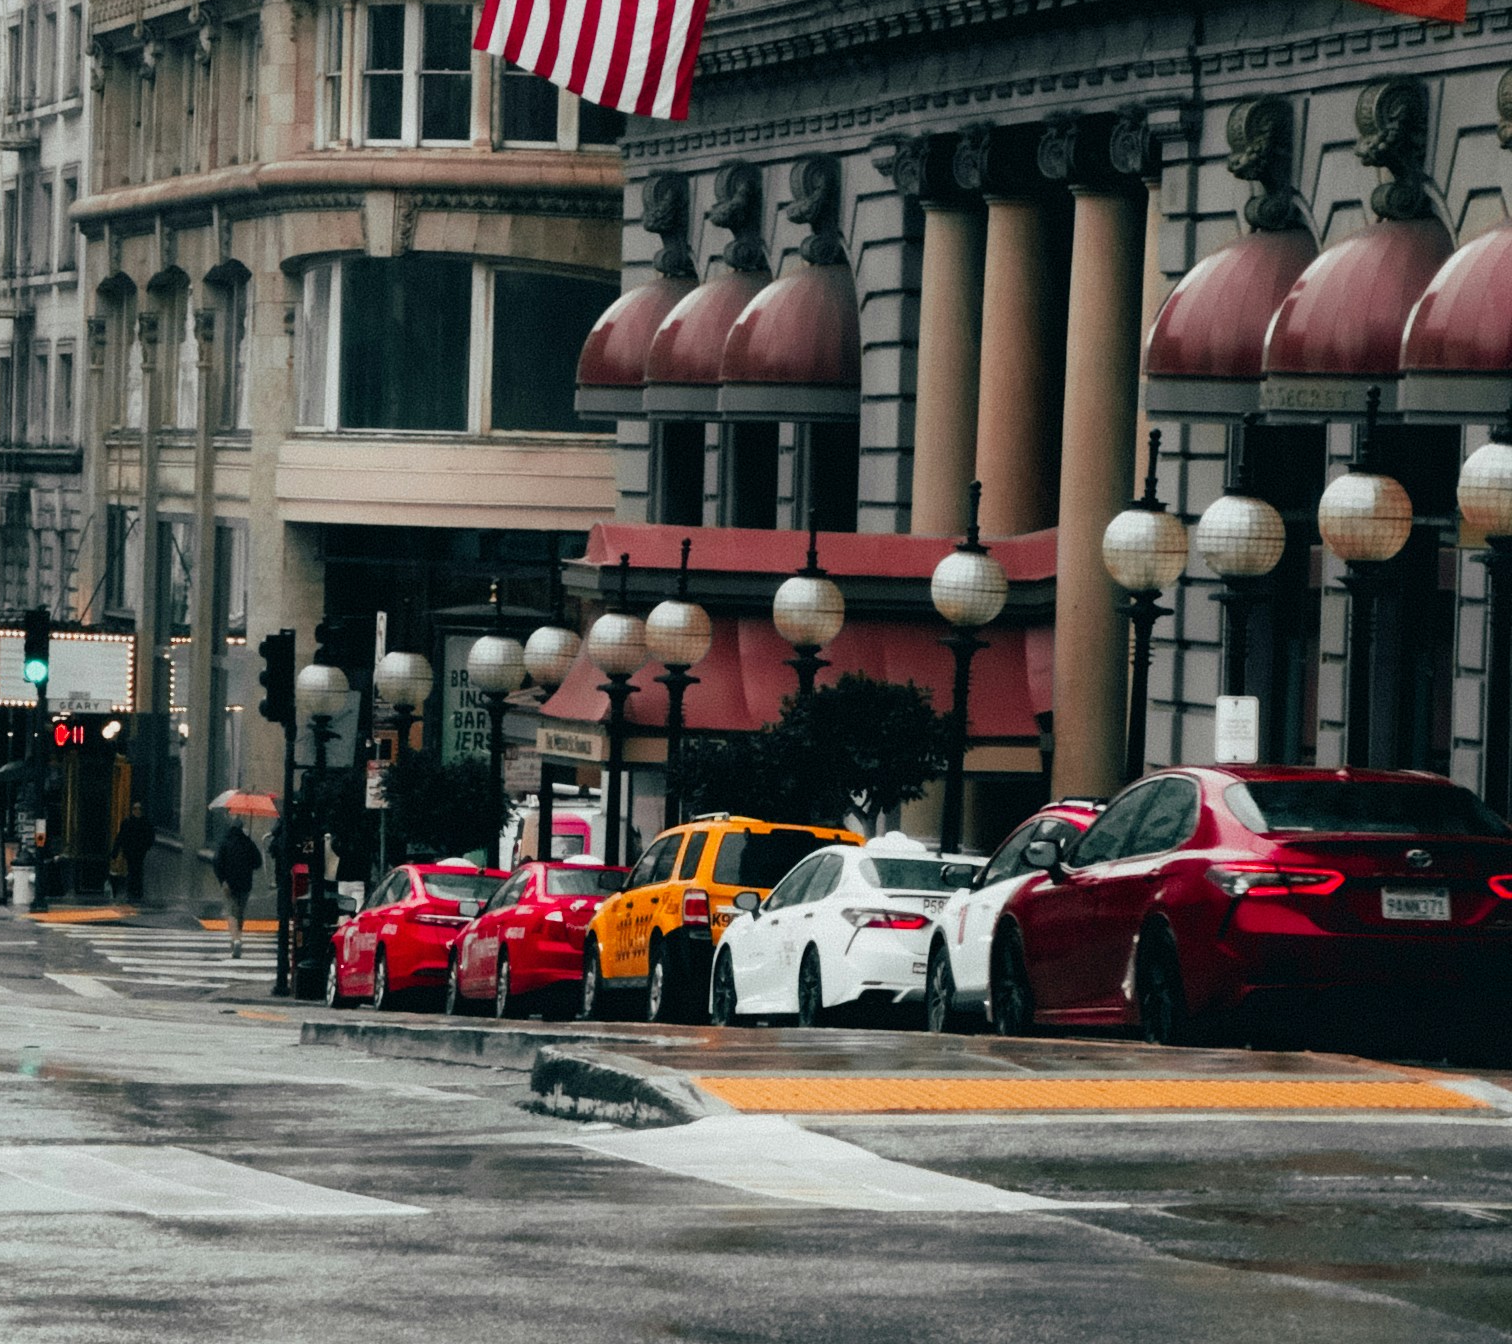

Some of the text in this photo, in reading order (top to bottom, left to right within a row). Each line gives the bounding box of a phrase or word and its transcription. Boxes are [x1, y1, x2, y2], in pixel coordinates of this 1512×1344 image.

[59, 701, 100, 711] GEARY
[923, 899, 946, 914] P58
[711, 913, 732, 928] K9
